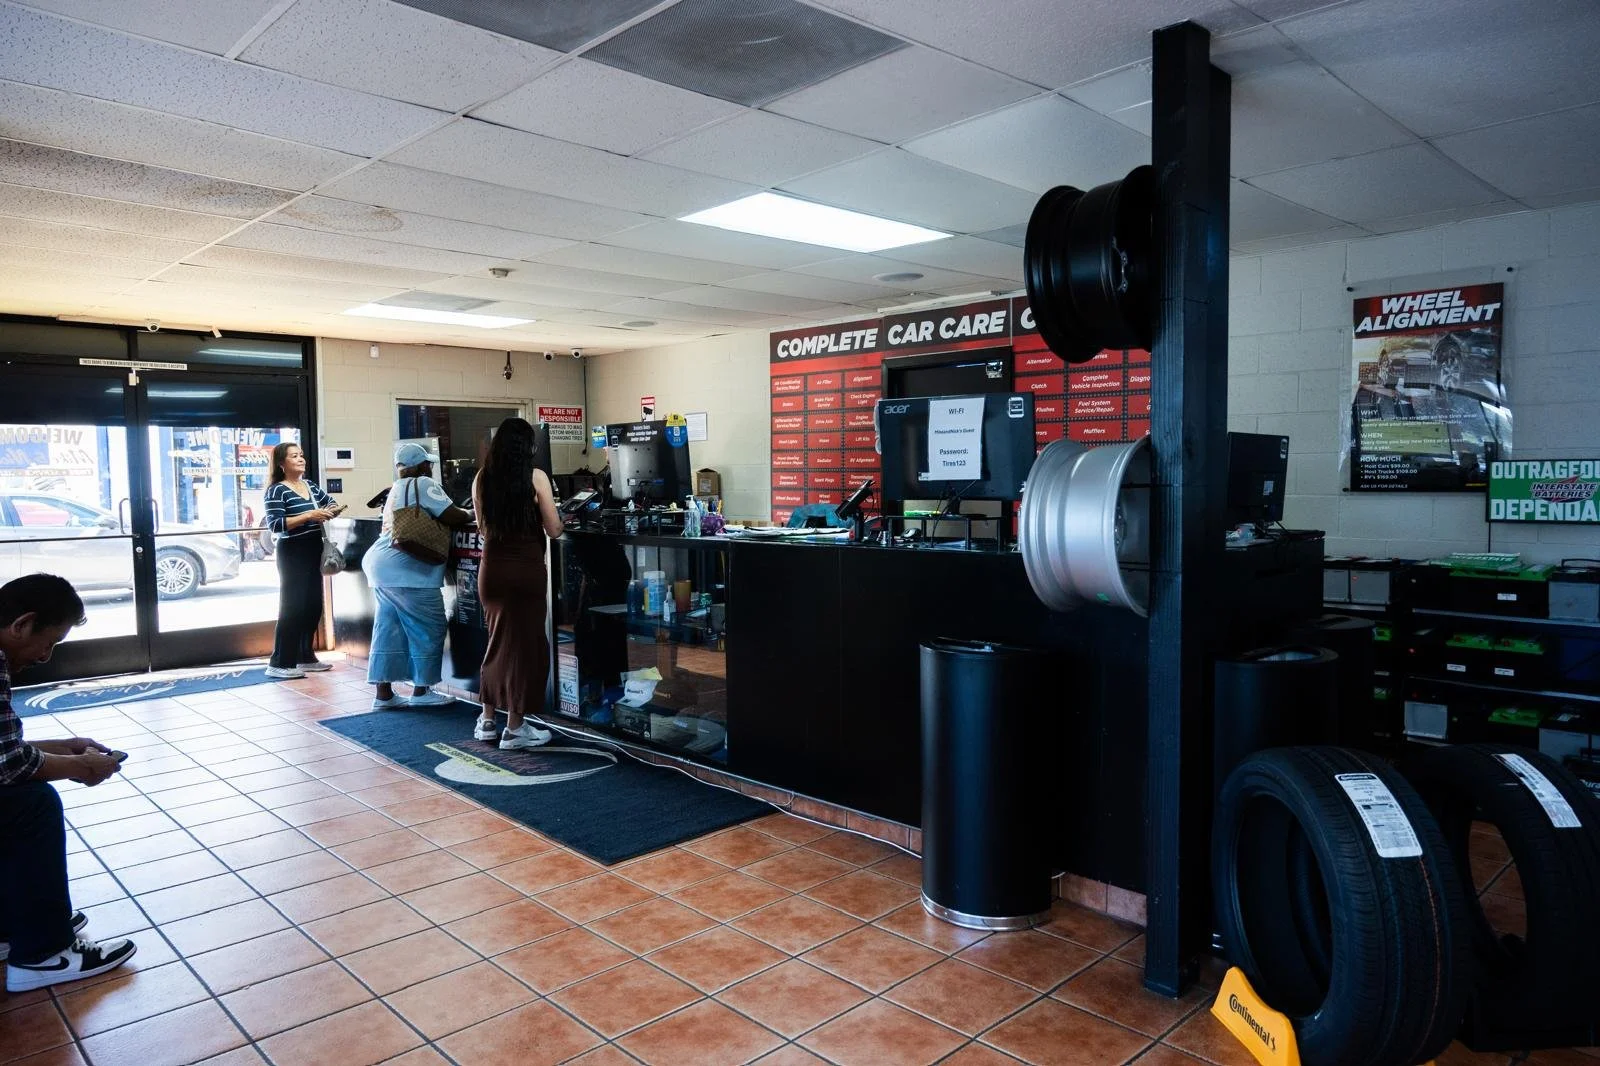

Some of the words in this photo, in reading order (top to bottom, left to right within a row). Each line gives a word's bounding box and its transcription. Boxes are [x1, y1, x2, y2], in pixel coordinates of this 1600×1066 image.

[1382, 290, 1466, 314] WHEEL
[1356, 302, 1500, 332] ALIGNMENT
[777, 328, 878, 358] COMPLETE
[888, 321, 934, 345] CAR
[939, 310, 1006, 340] CARE
[884, 403, 910, 414] acer
[1490, 499, 1600, 521] DEPENDA
[560, 700, 578, 714] AVISO
[1230, 994, 1270, 1045] Continental
